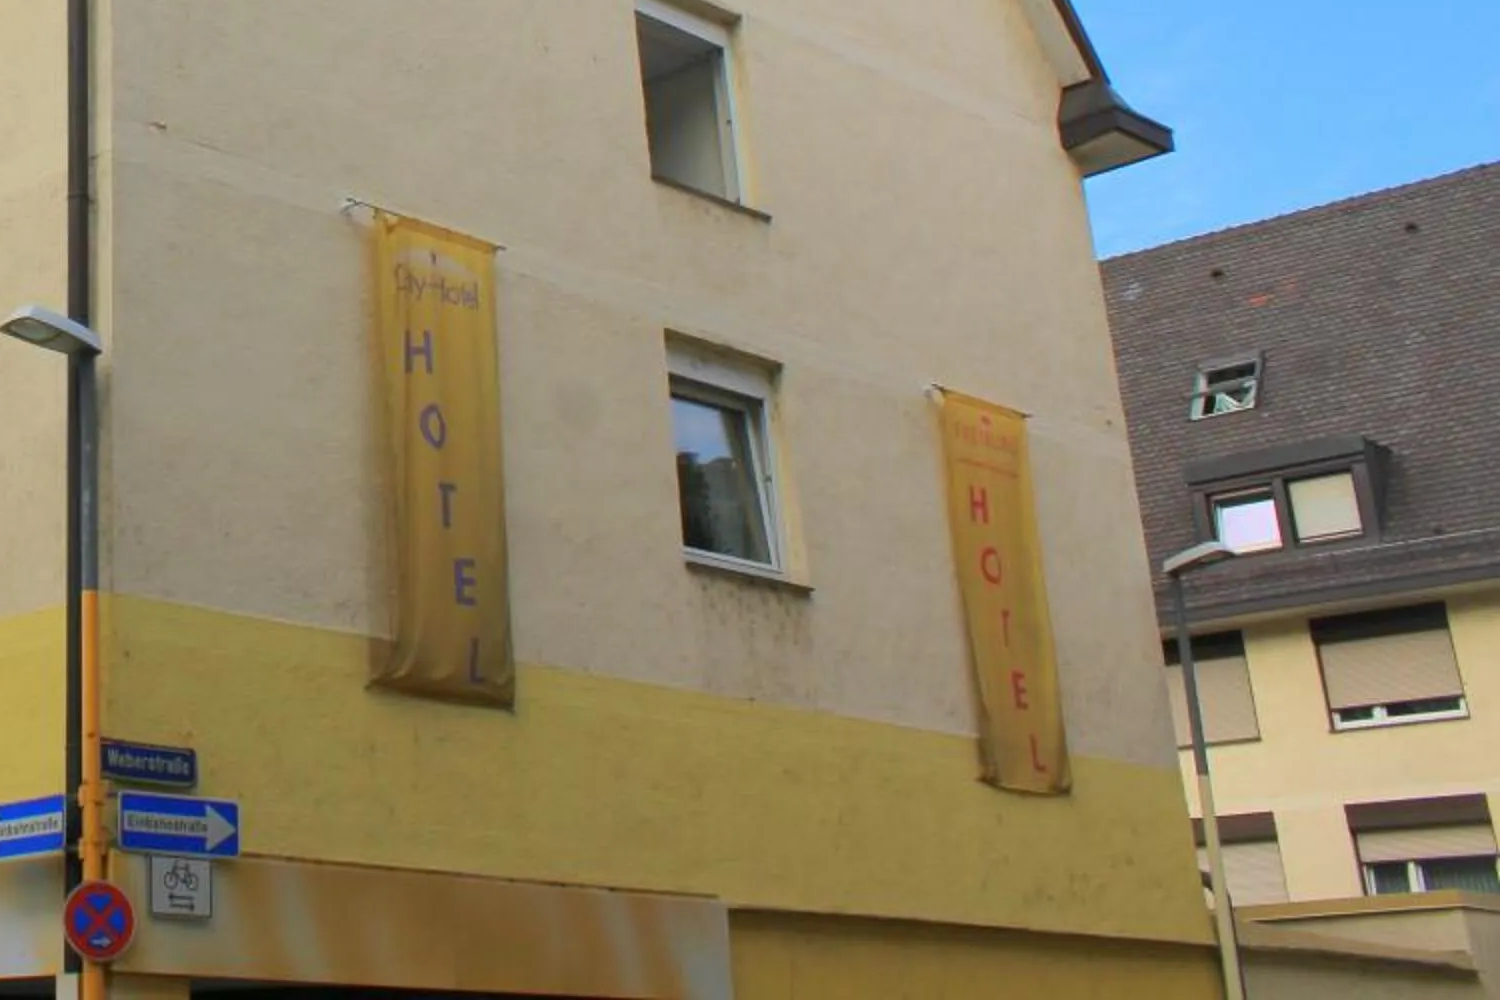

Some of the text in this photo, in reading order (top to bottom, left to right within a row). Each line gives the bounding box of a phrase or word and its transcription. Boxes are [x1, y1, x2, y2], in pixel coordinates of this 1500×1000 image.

[403, 328, 486, 685] HOTEL
[968, 485, 1048, 774] HOTEL
[107, 748, 190, 775] Weberstraße
